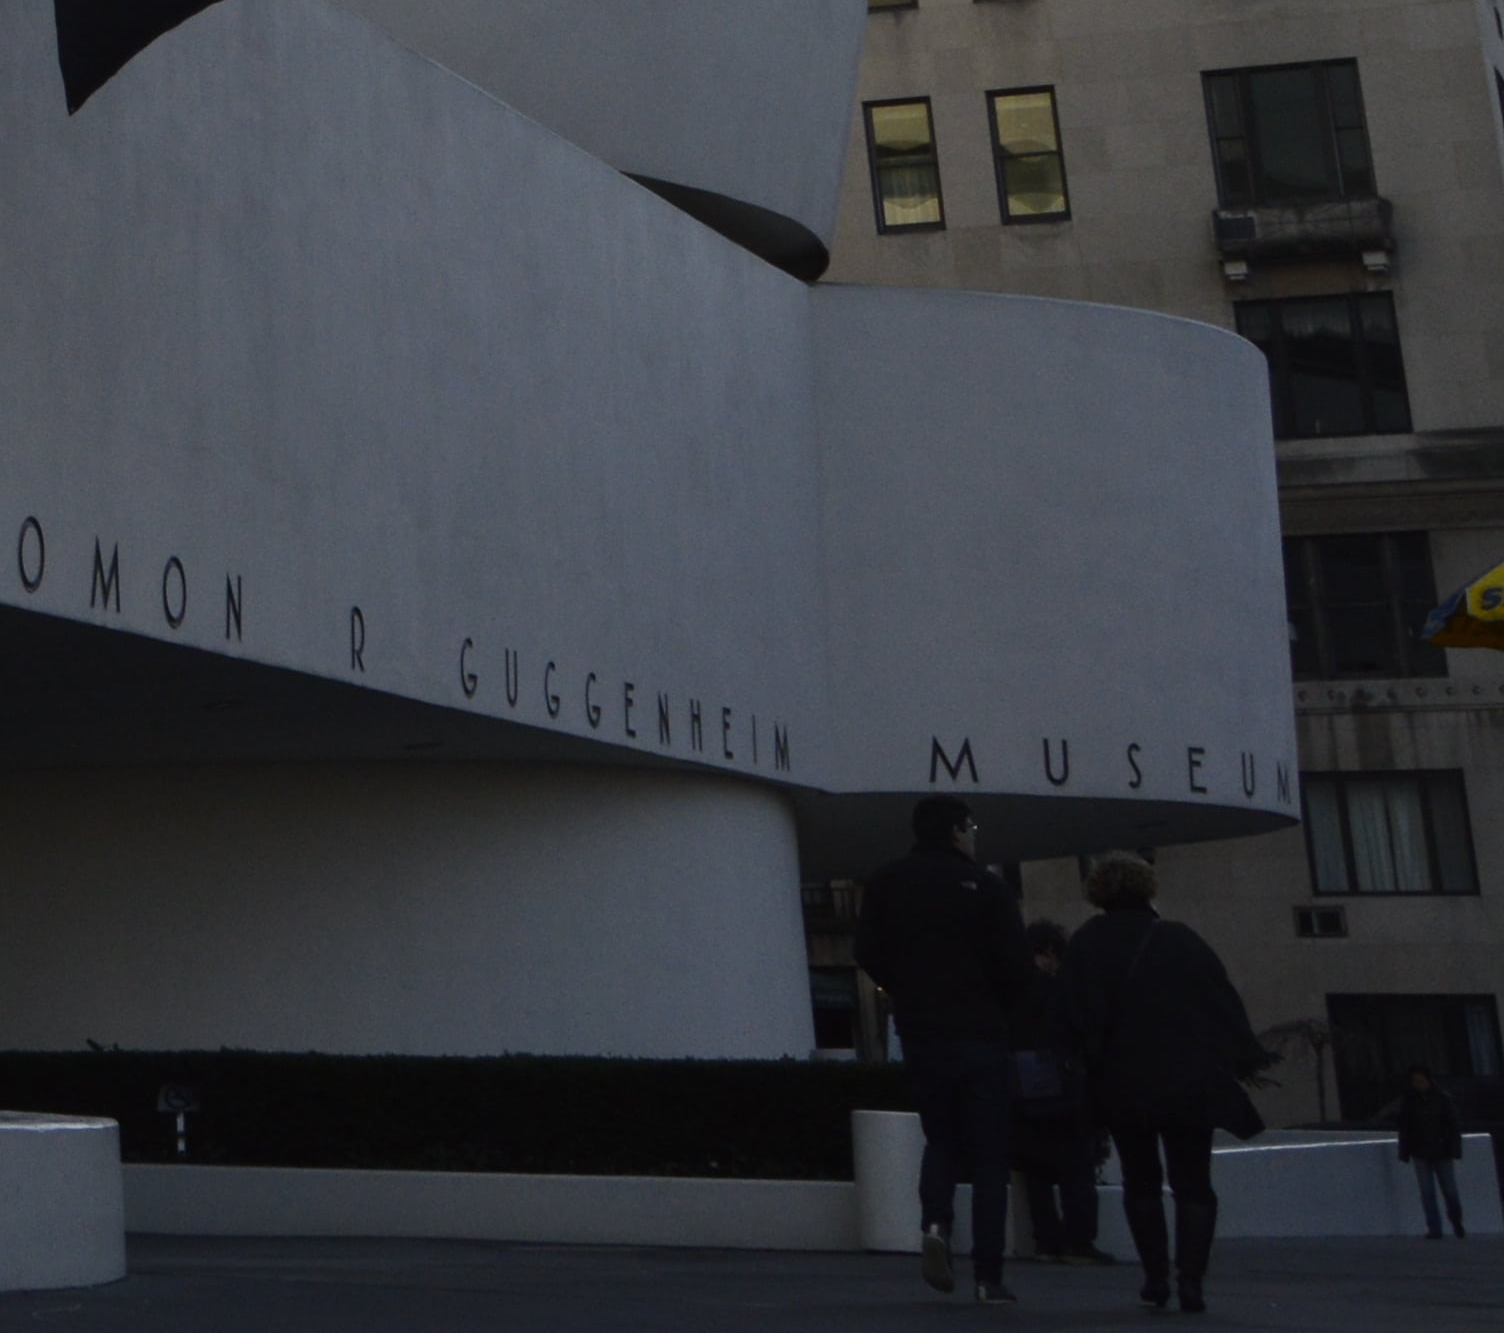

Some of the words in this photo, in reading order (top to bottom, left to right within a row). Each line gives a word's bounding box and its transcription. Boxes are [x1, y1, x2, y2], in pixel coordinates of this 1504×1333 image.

[349, 604, 366, 673] R
[459, 636, 791, 771] GUGGENHEIM
[928, 735, 1290, 805] MUSEUM
